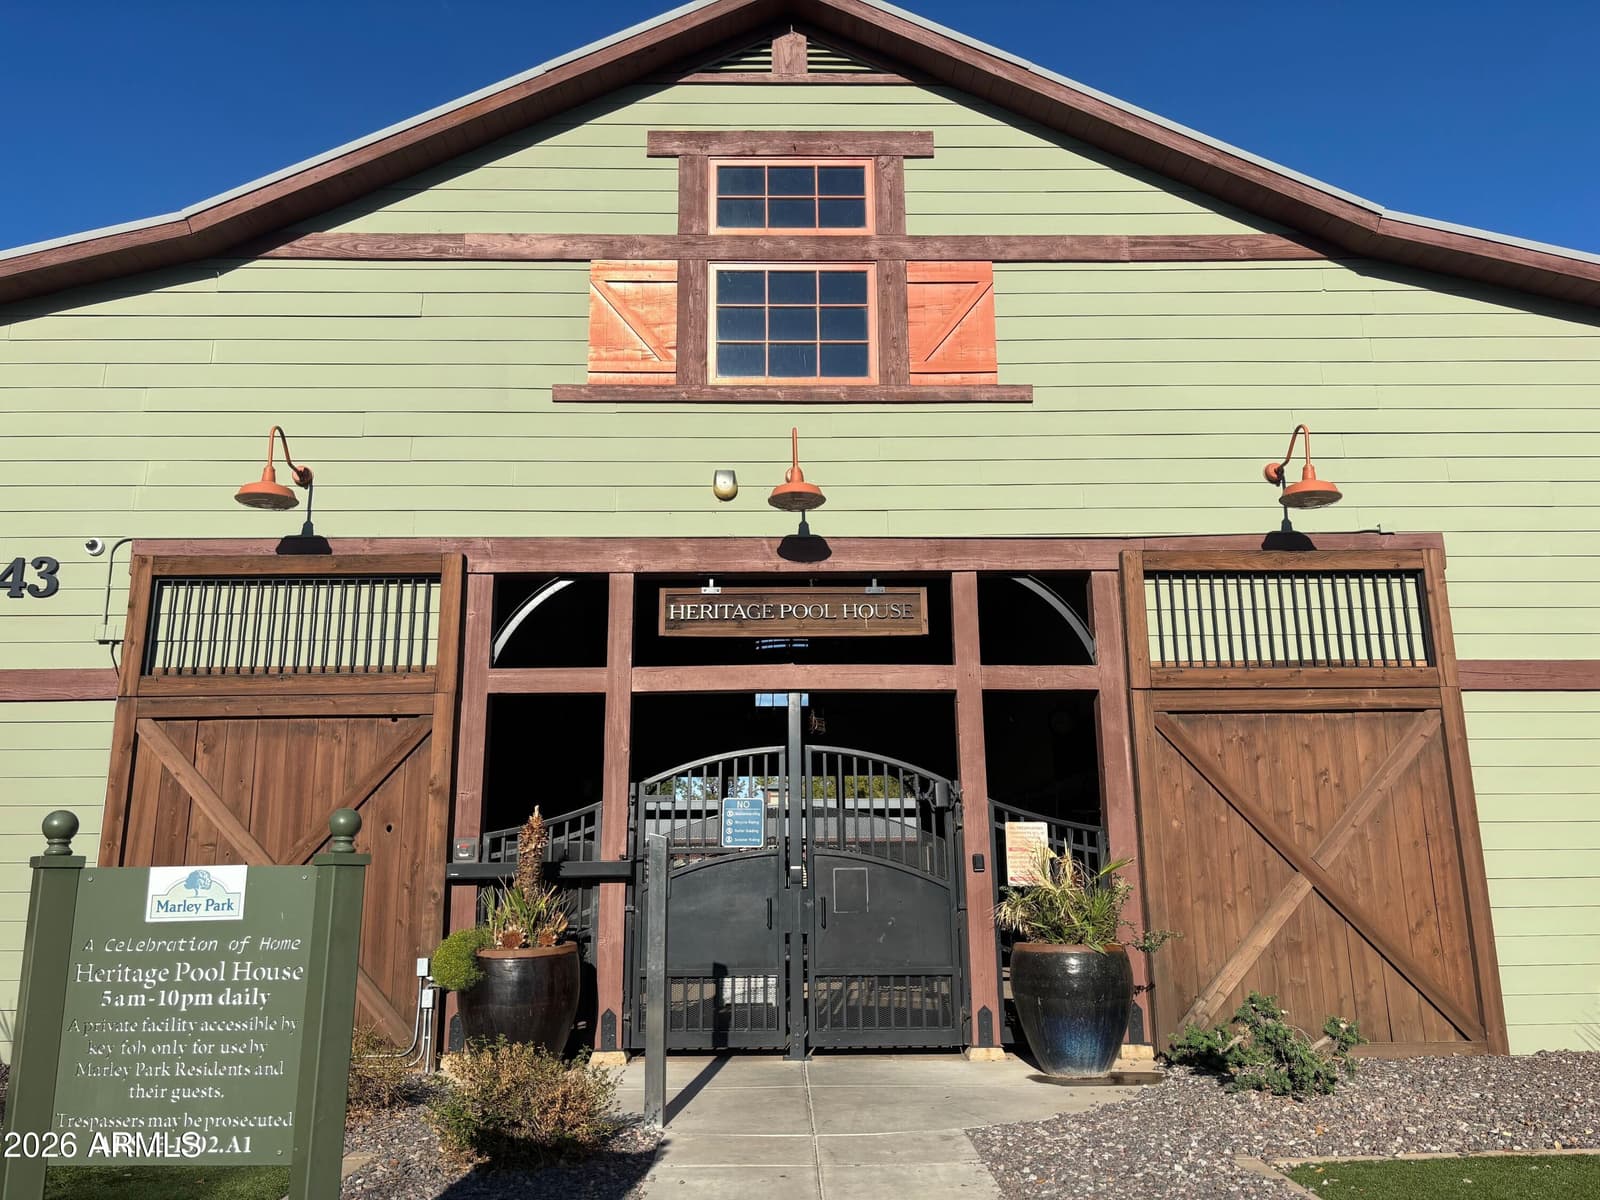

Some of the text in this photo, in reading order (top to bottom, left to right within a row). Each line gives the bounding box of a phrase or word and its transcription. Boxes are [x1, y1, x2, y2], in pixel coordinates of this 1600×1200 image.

[0, 556, 60, 598] 43
[669, 602, 915, 620] HERITAGE POOL HOUSE
[736, 800, 751, 809] NO
[156, 898, 235, 915] Marley Park
[82, 935, 302, 954] A Celebration of Home
[75, 960, 304, 989] Heritage Pool House
[100, 987, 271, 1012] 5am-10pm daily
[66, 1015, 298, 1037] A private facility accessible by
[87, 1038, 268, 1059] key fob only for use by
[76, 1060, 285, 1081] Marley Park Residents and
[128, 1083, 225, 1103] their guests.
[56, 1111, 294, 1131] Trespassers may be prosecuted
